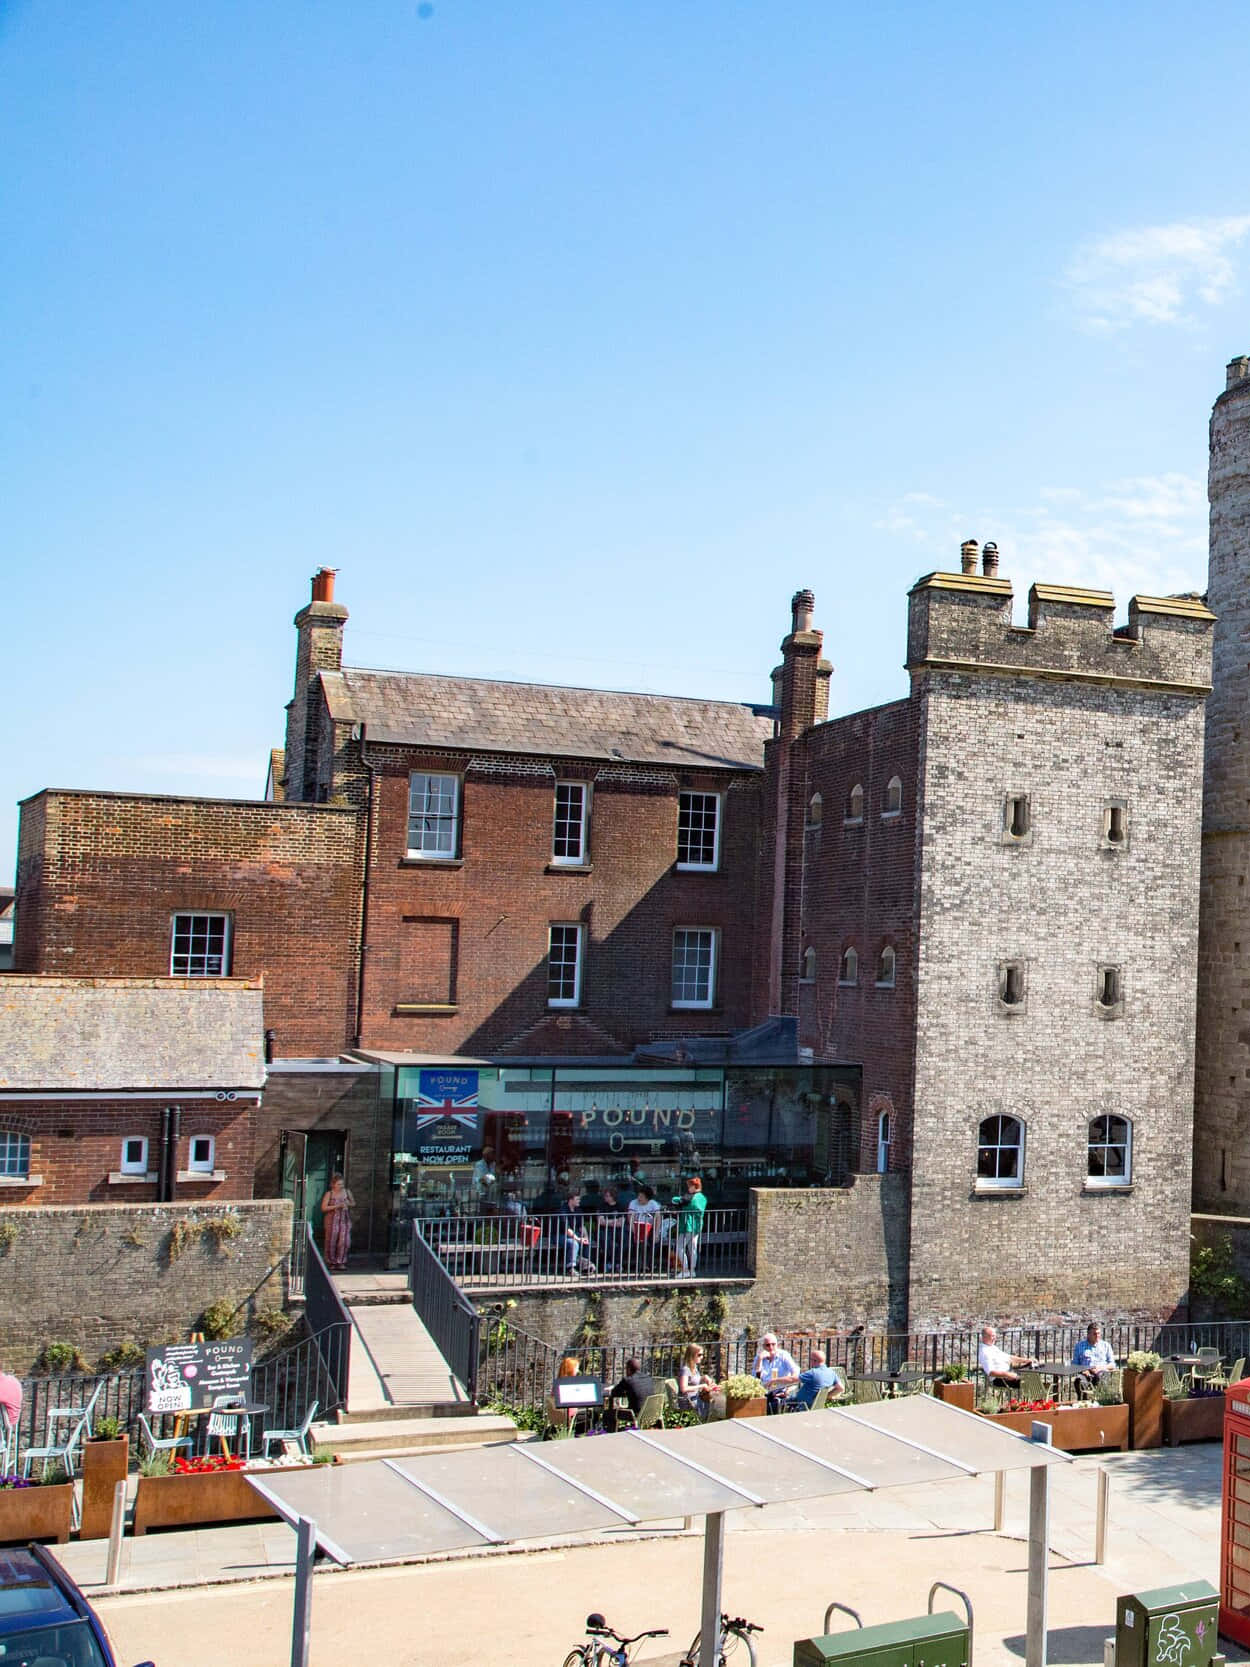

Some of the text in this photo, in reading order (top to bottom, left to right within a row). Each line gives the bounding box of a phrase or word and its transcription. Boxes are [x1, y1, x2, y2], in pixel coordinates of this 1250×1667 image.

[430, 1075, 468, 1085] POUND
[581, 1108, 695, 1129] POUND
[420, 1145, 473, 1153] RESTAURANT
[422, 1155, 470, 1164] NOW OPEN
[206, 1346, 243, 1356] POUND
